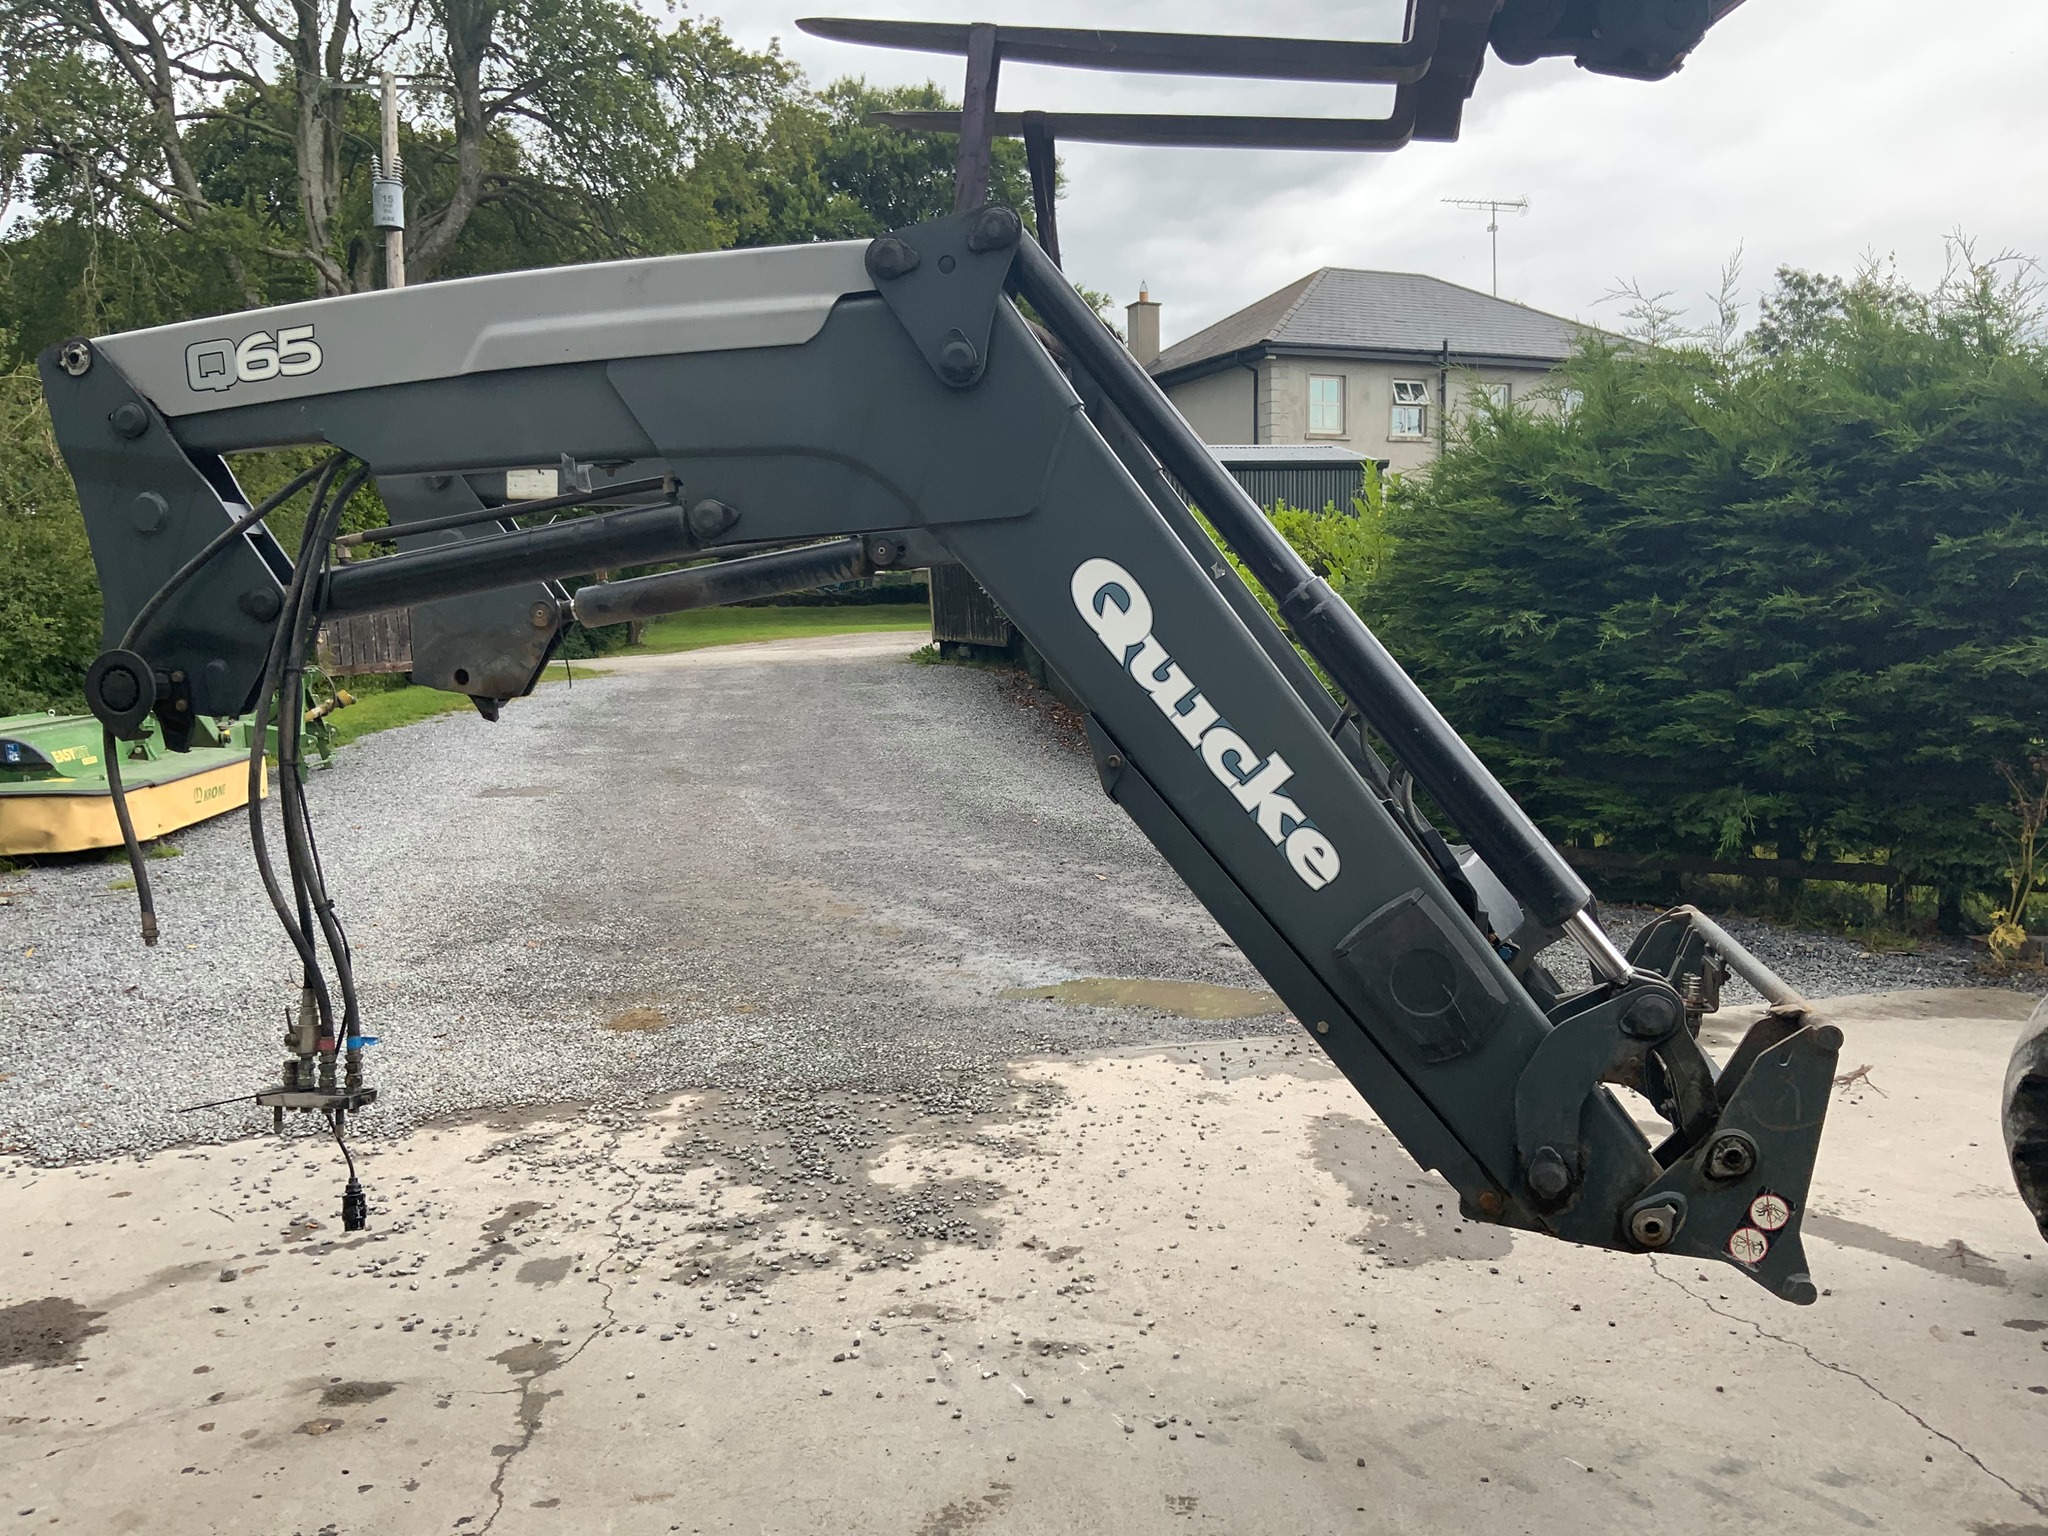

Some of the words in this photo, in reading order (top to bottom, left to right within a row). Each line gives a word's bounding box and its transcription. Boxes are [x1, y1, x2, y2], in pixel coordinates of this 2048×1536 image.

[382, 194, 394, 203] 15
[185, 324, 323, 392] Q65
[1070, 557, 1341, 891] Quicke
[203, 783, 226, 802] KRONE
